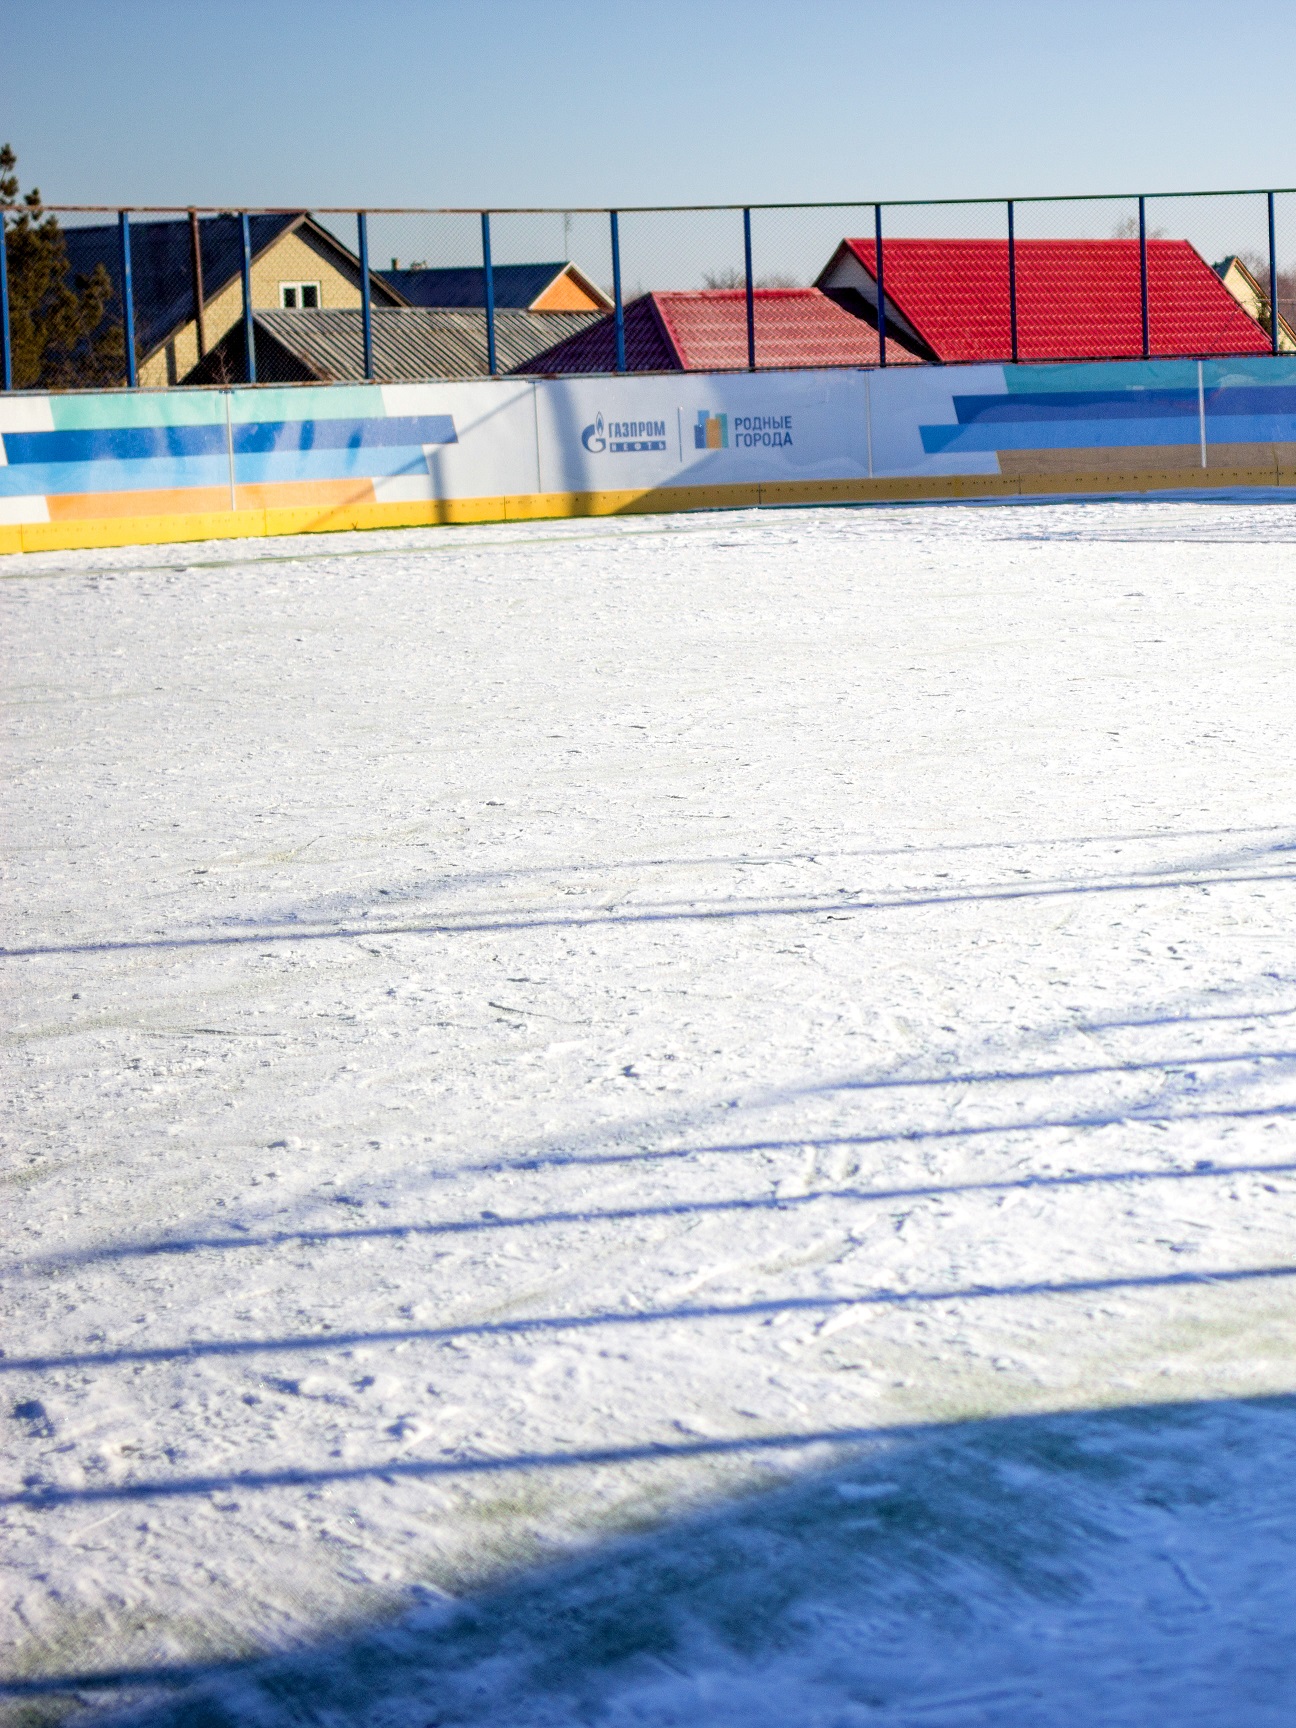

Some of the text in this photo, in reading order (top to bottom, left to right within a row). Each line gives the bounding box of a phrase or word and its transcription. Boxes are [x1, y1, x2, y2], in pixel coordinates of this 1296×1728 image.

[608, 420, 666, 438] ГАЗПРОМ
[735, 416, 792, 431] РОДНЫЕ
[611, 441, 665, 452] НЕФТЬ
[736, 431, 793, 447] ГОРОДА
